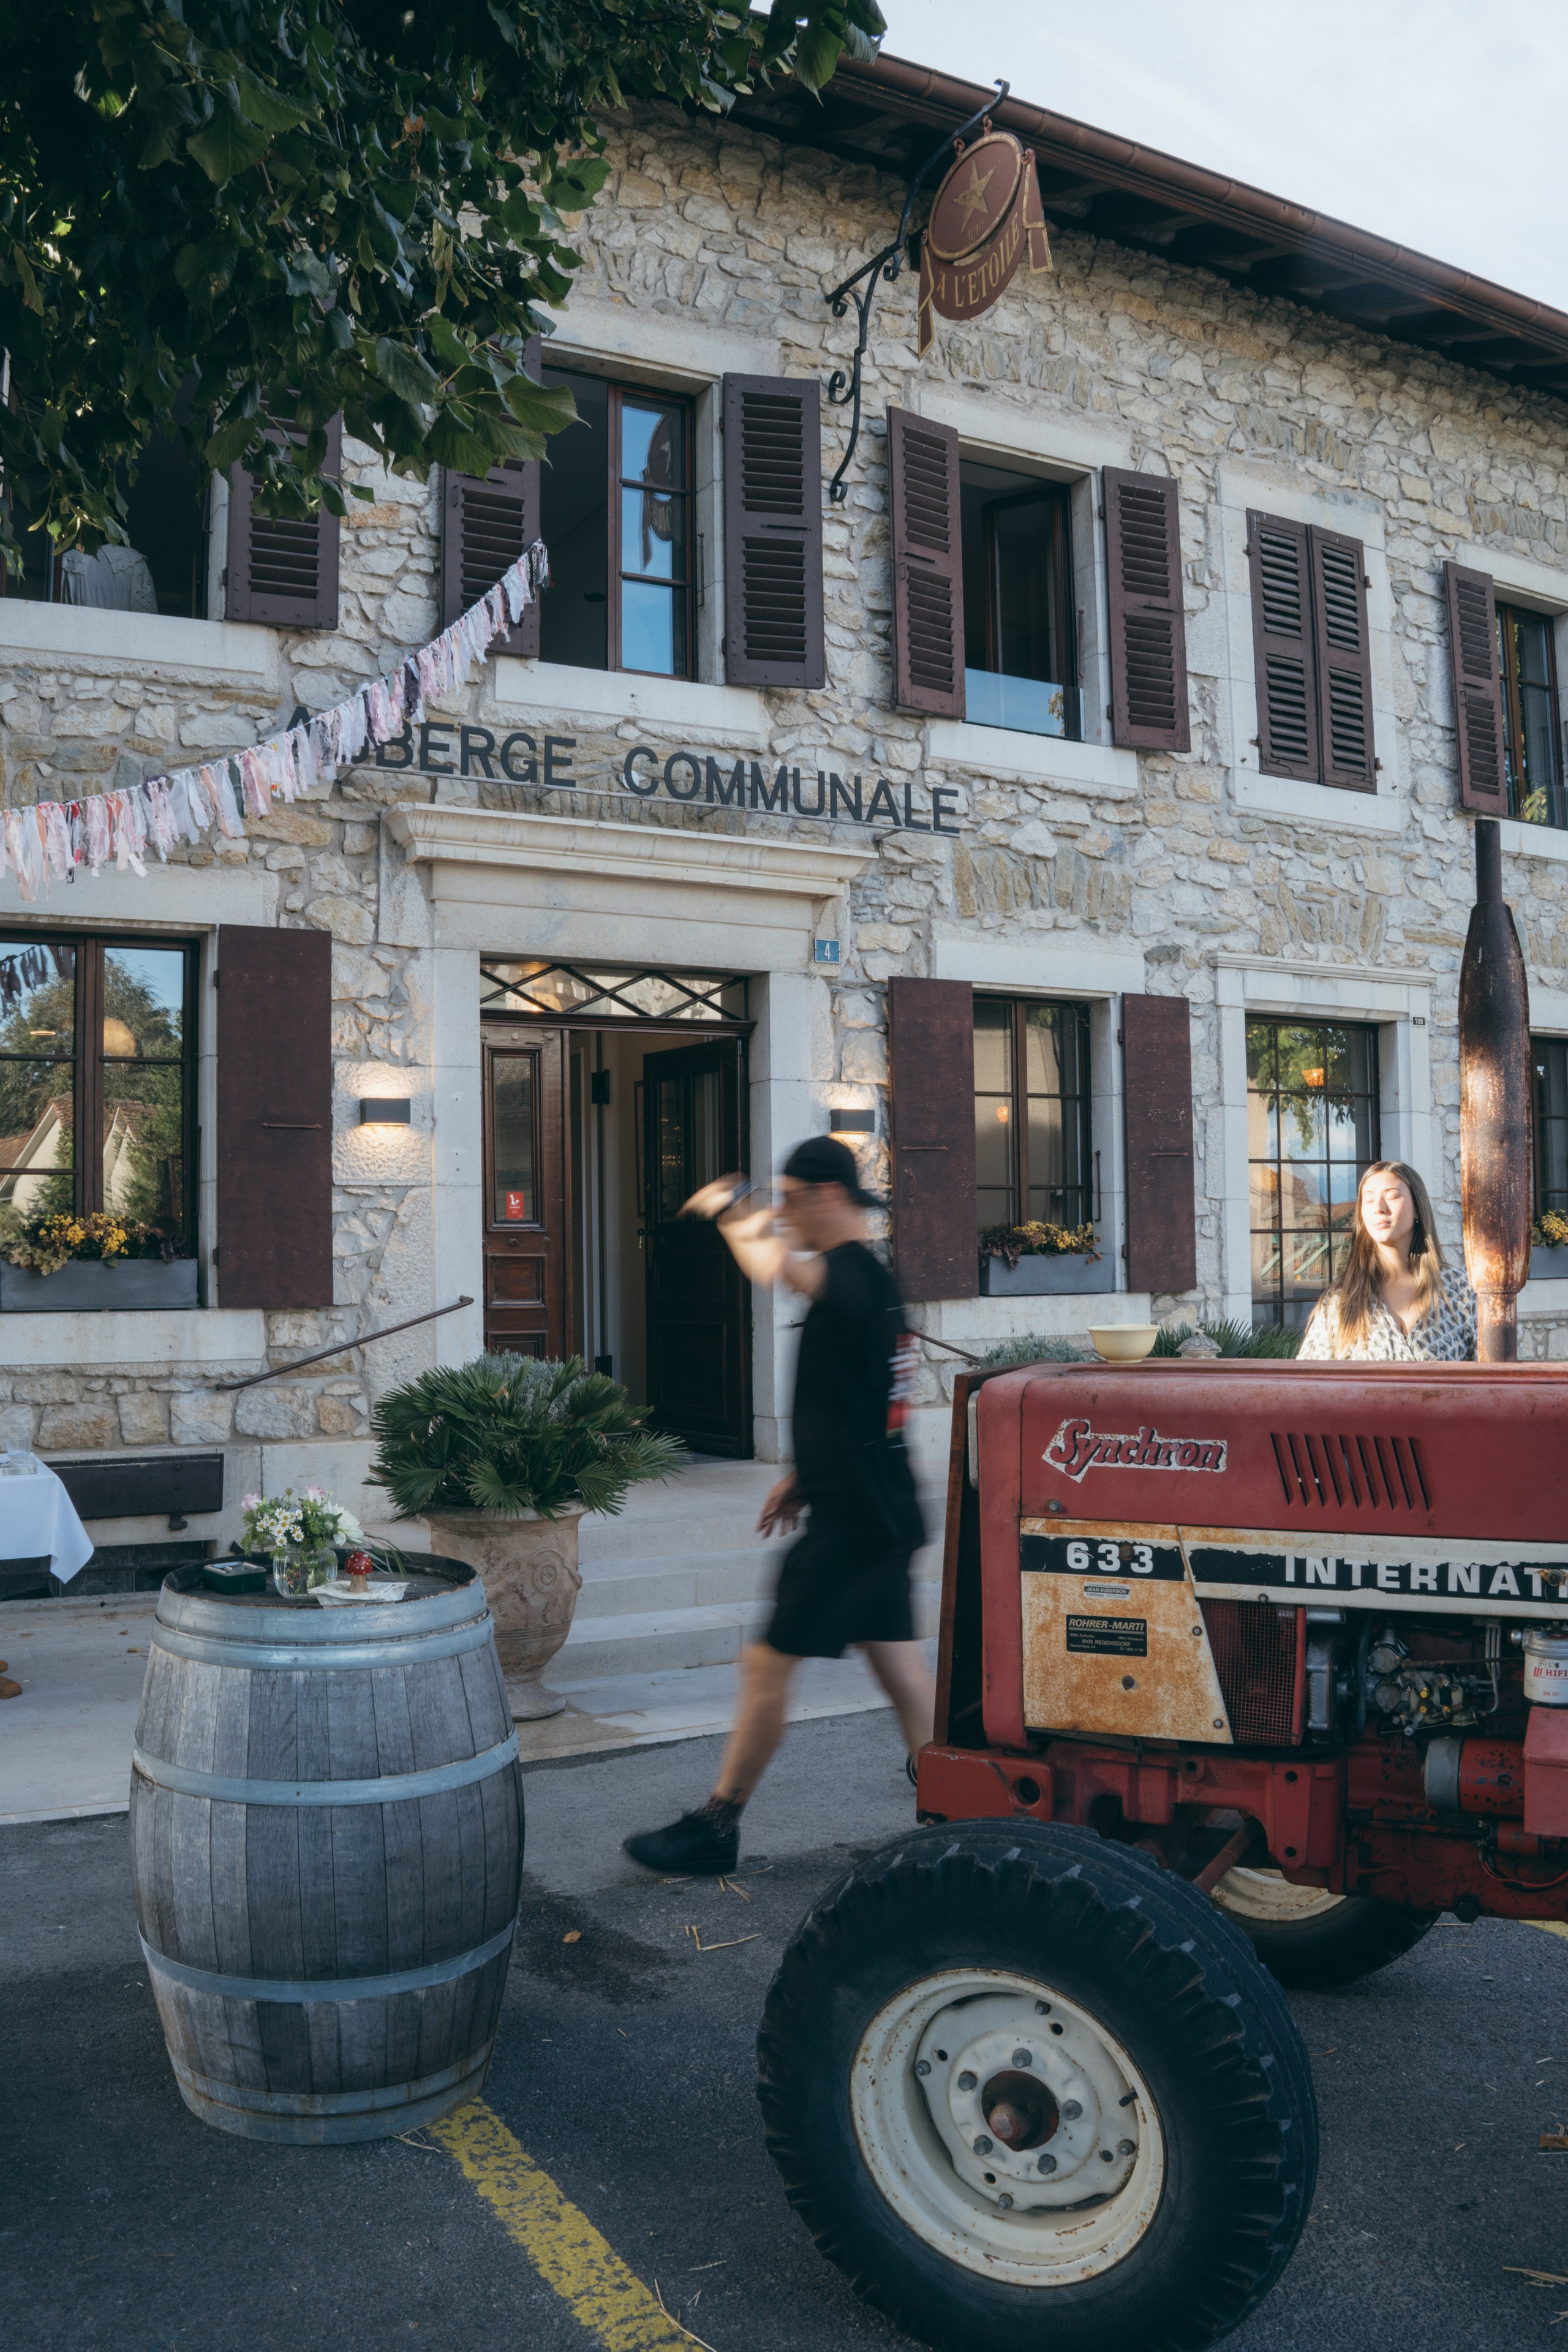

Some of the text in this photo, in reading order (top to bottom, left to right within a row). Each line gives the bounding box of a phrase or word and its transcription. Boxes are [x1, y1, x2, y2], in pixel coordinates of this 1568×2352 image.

[954, 211, 1020, 307] L'ETOILE
[285, 706, 960, 834] ABERGE COMMUNALE
[824, 943, 831, 960] 4
[1050, 1420, 1224, 1476] Synchron
[1067, 1542, 1153, 1574] 633
[1069, 1618, 1144, 1630] ROHRER-MARTI
